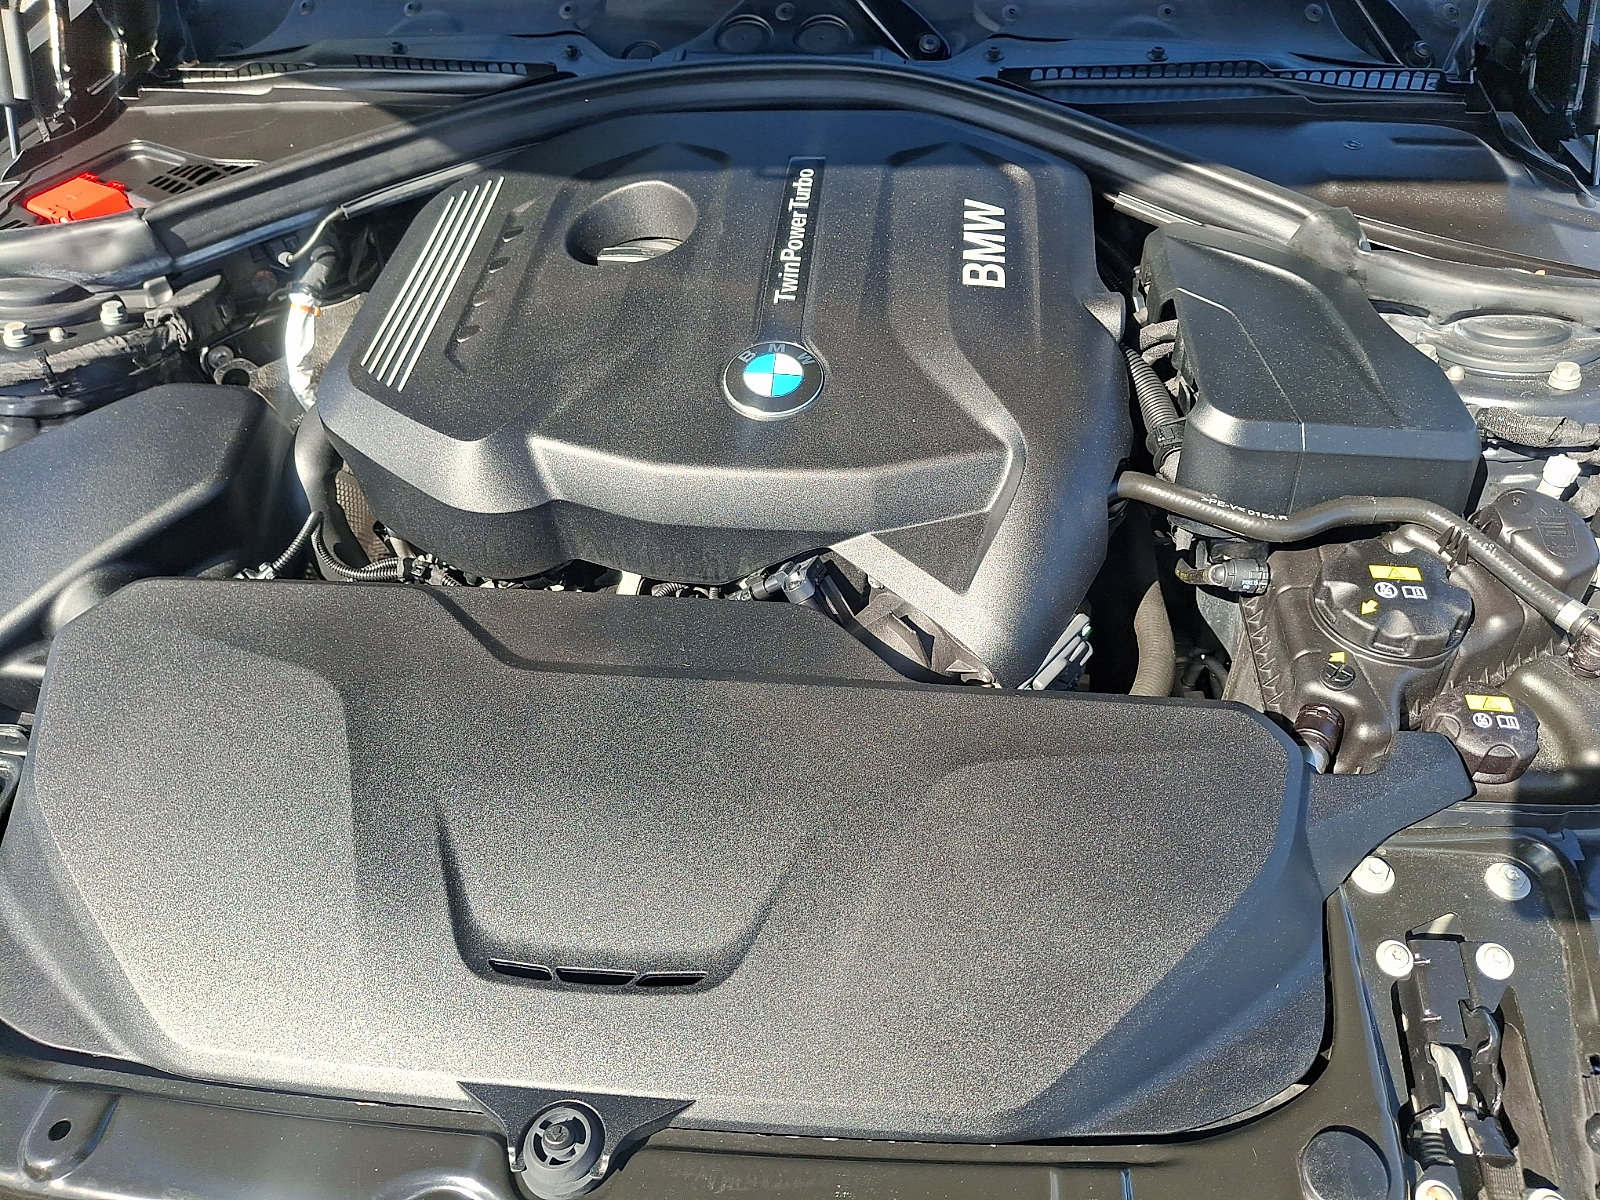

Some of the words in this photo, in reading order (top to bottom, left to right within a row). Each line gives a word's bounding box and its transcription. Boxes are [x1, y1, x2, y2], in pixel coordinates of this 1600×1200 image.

[788, 168, 815, 212] Turbo
[774, 210, 808, 304] TwinPower
[962, 198, 1006, 289] BMW
[737, 343, 817, 366] BMW
